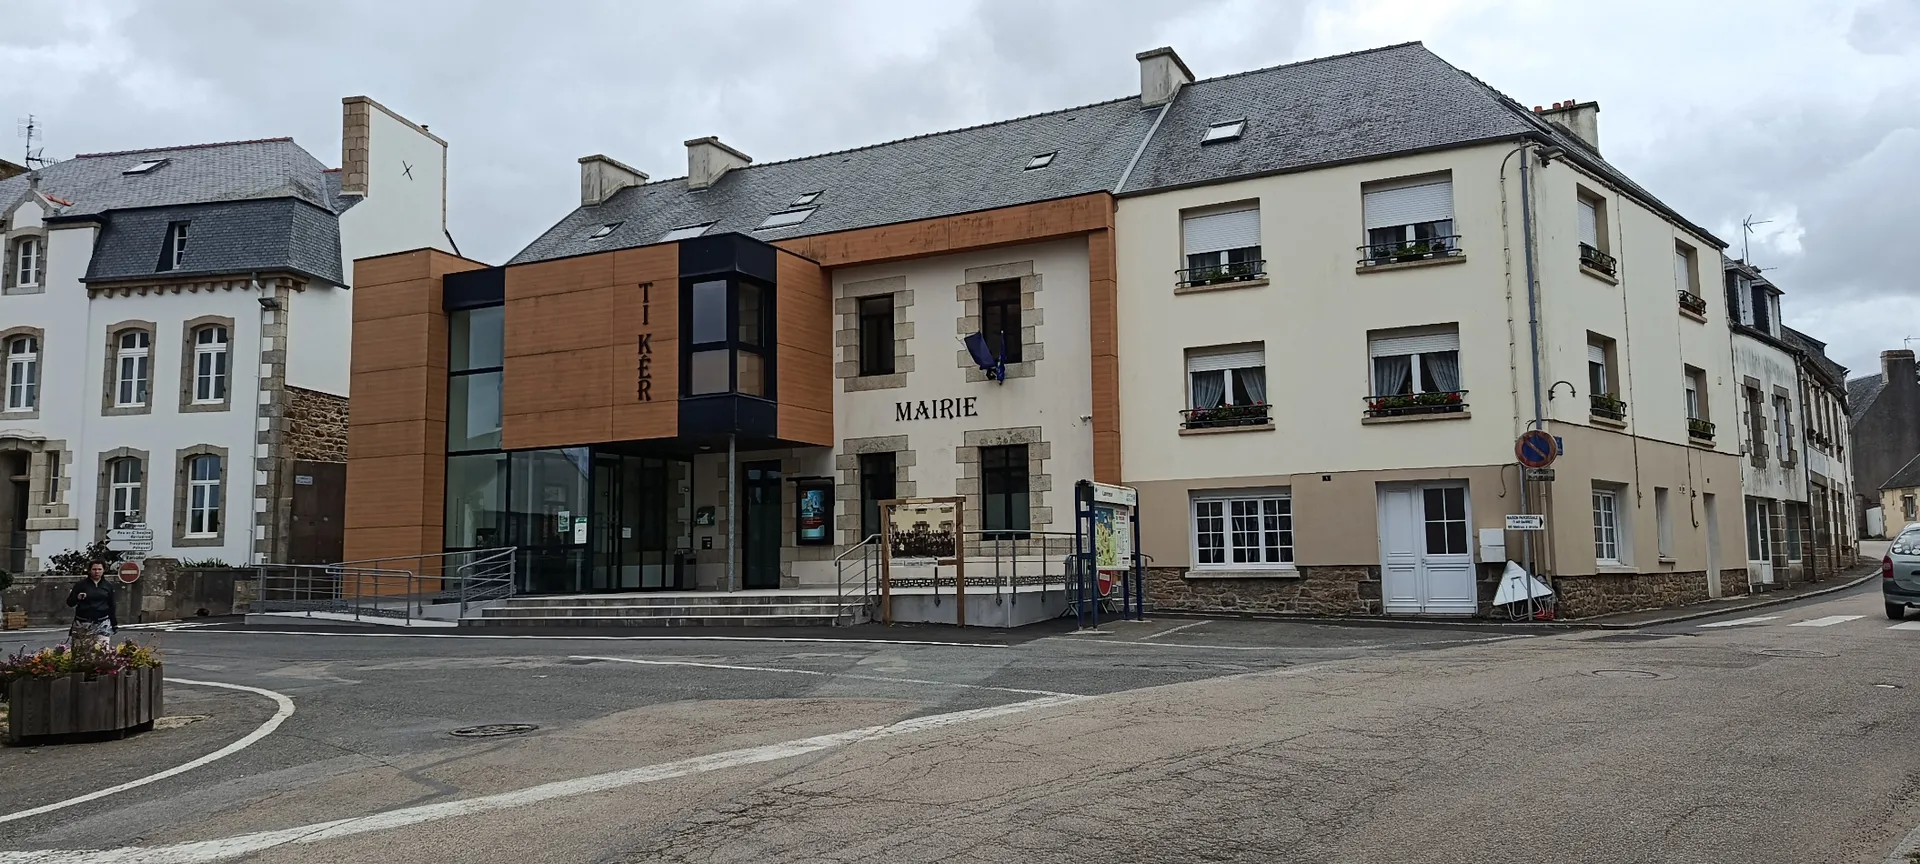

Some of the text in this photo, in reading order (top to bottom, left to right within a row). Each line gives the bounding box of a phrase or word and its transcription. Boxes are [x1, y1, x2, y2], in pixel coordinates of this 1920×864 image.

[637, 281, 653, 401] TI KÊR
[895, 397, 978, 421] MAIRIE
